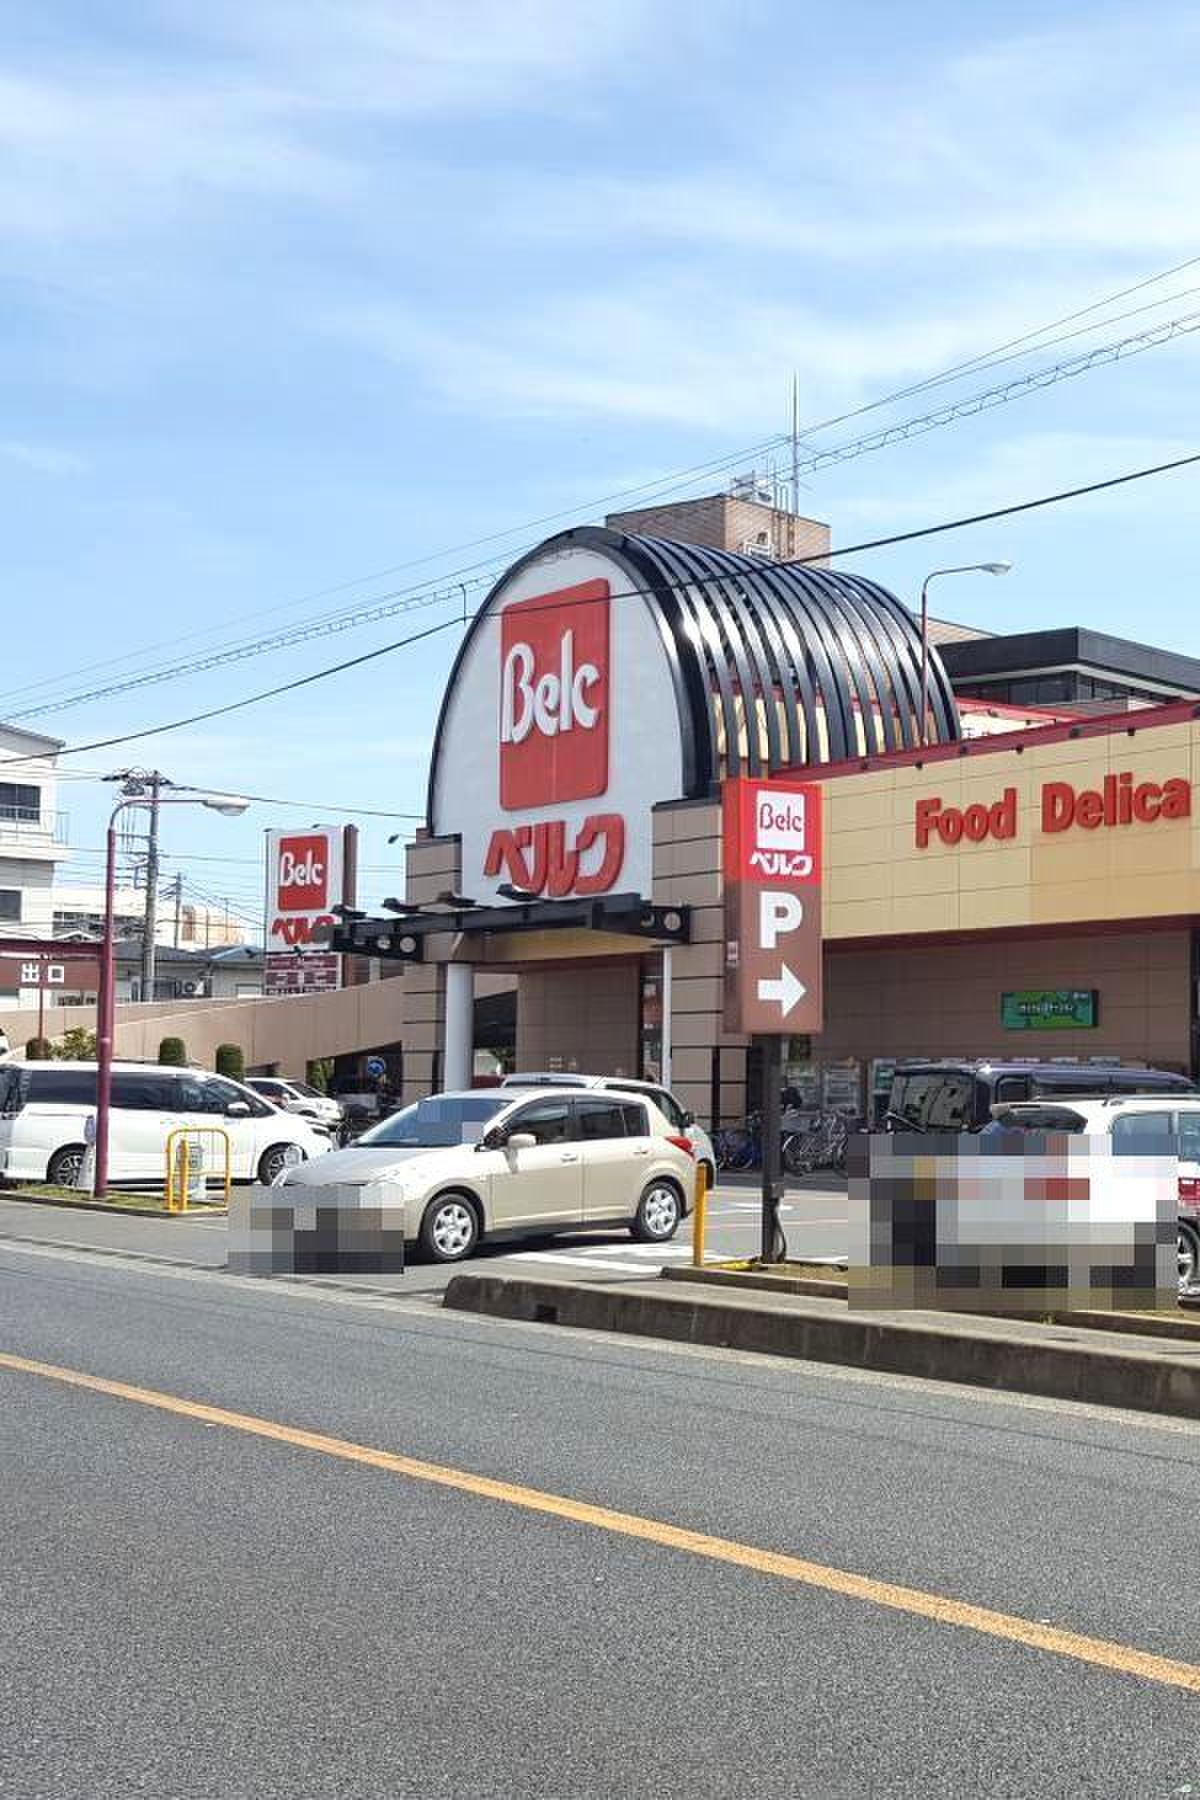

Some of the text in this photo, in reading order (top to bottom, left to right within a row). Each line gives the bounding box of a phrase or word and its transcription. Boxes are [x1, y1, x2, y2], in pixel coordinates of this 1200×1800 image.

[501, 631, 600, 744] Belc
[760, 803, 802, 832] Belc
[915, 788, 1017, 848] Food
[1041, 772, 1192, 832] Delica
[280, 851, 323, 887] Belc
[484, 814, 625, 896] ベルク
[749, 852, 813, 876] ベルク
[760, 891, 802, 949] P
[21, 962, 64, 983] 出口
